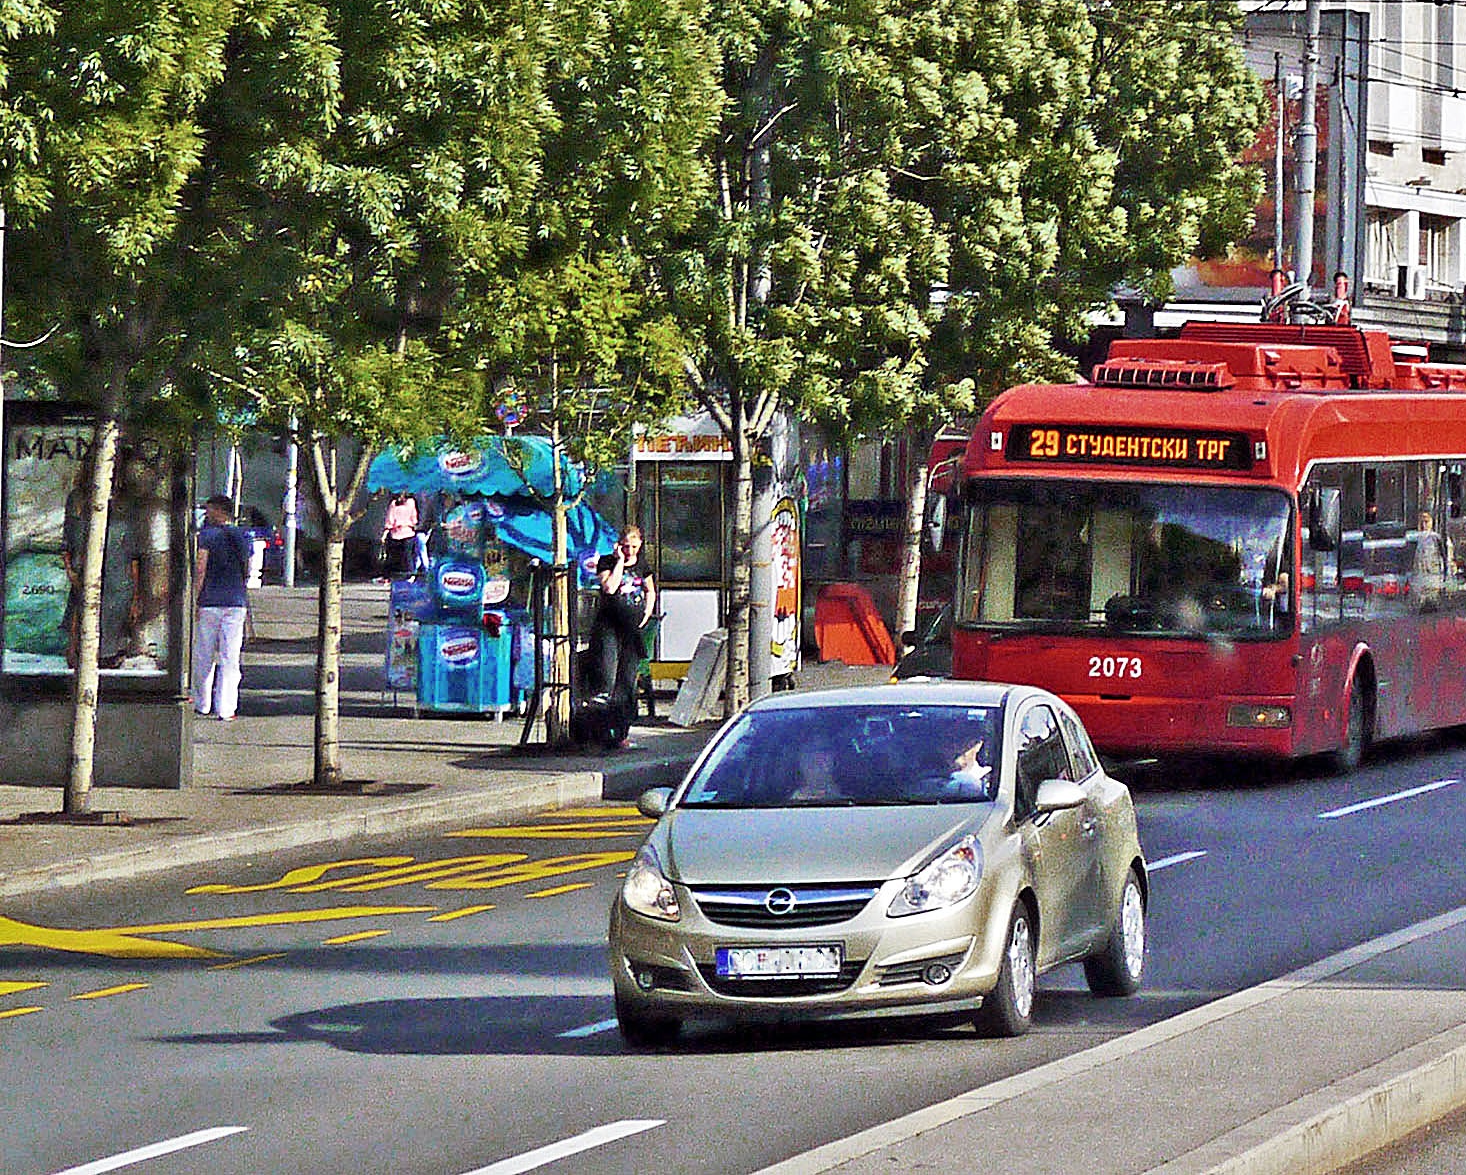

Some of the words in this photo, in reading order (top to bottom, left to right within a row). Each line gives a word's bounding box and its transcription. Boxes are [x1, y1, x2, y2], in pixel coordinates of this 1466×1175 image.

[1030, 430, 1060, 456] 29
[1066, 434, 1188, 460] СТУДЕНТСКИ
[1196, 440, 1230, 461] ТРГ
[1088, 657, 1142, 678] 2073
